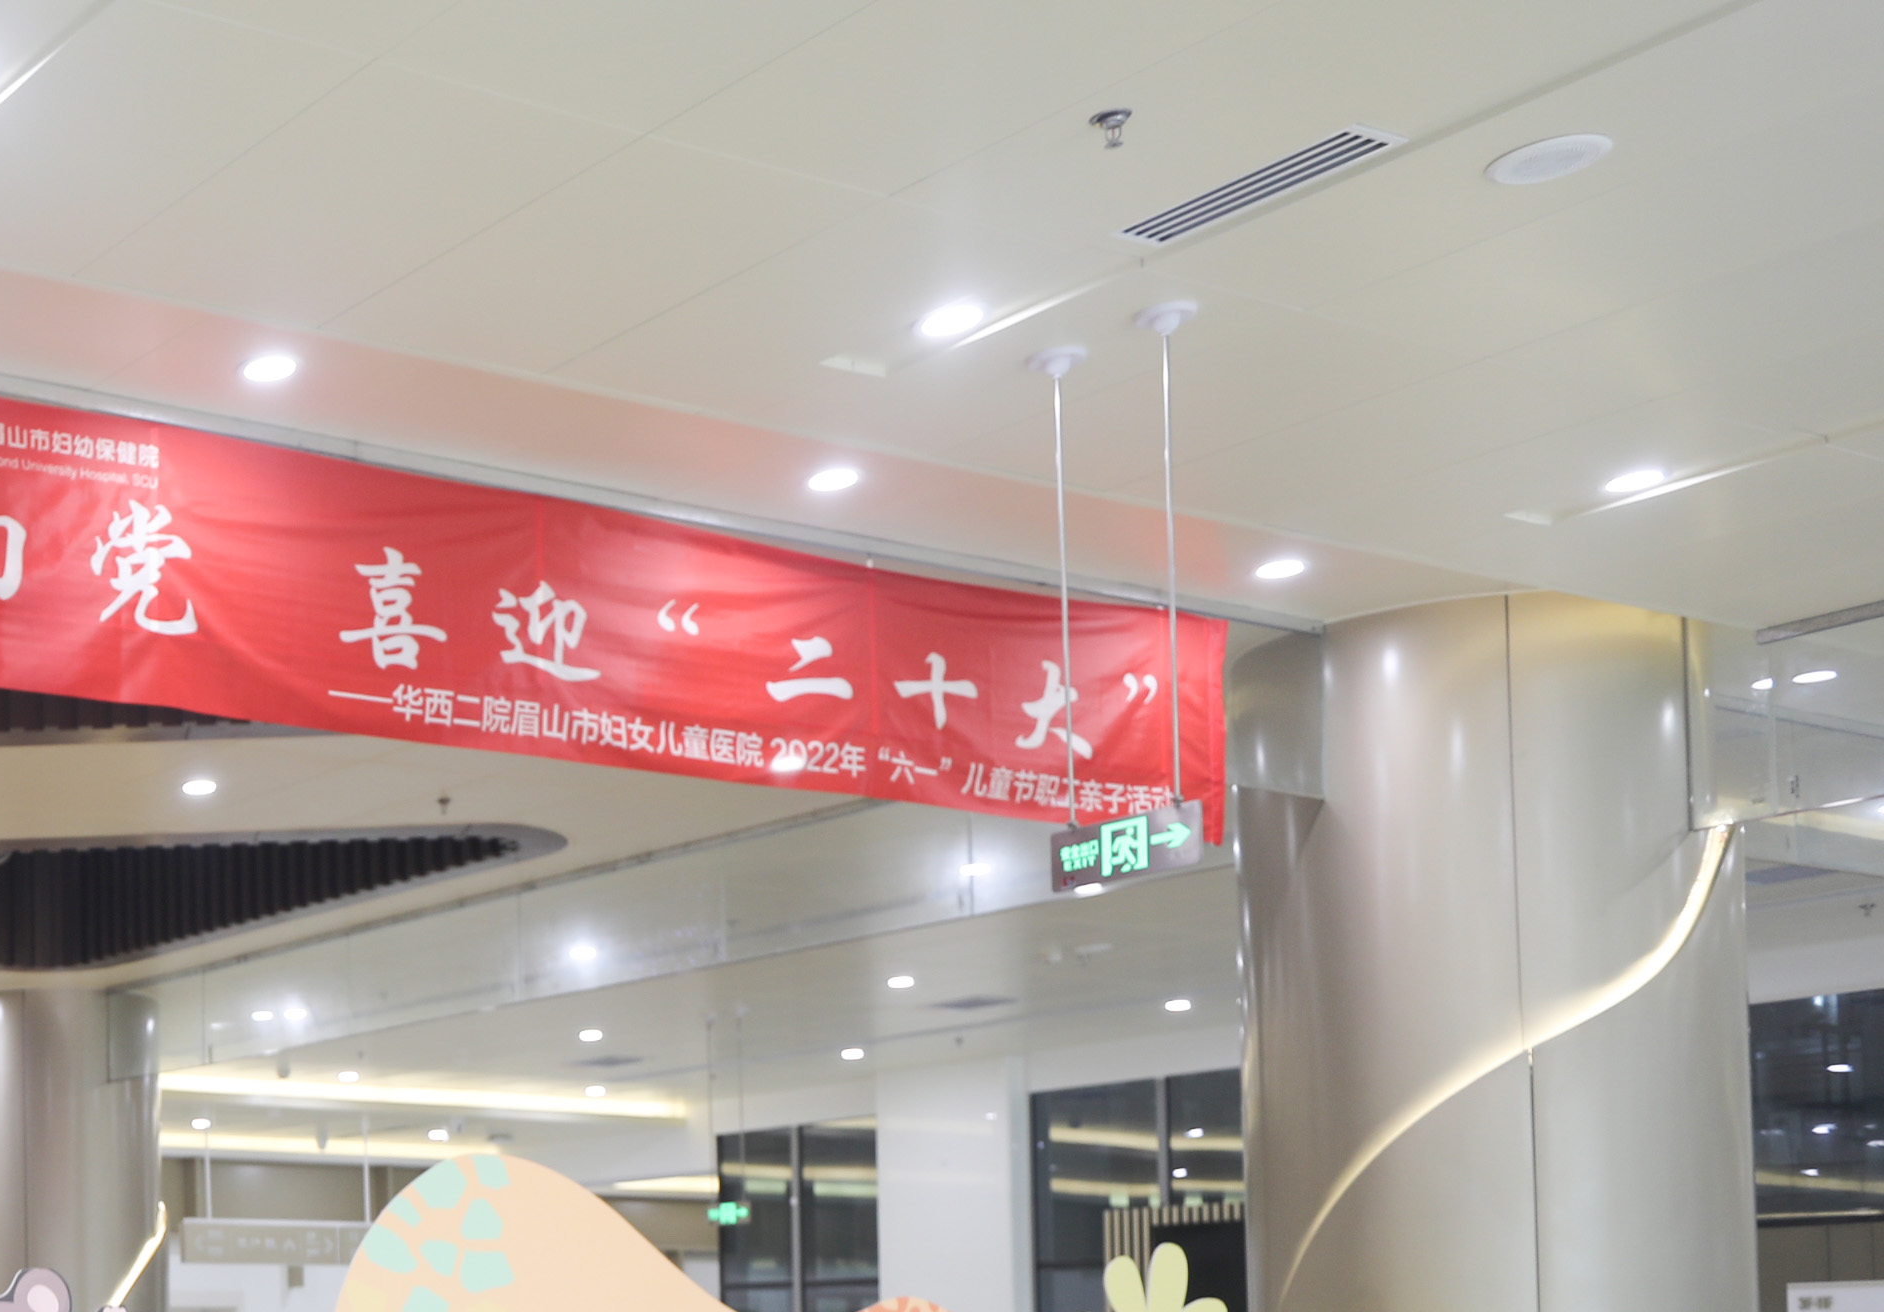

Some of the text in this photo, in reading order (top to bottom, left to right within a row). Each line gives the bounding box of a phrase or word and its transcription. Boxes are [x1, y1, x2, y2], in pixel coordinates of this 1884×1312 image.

[21, 456, 79, 481] University
[131, 473, 159, 490] SCU
[1062, 854, 1097, 873] EXIT
